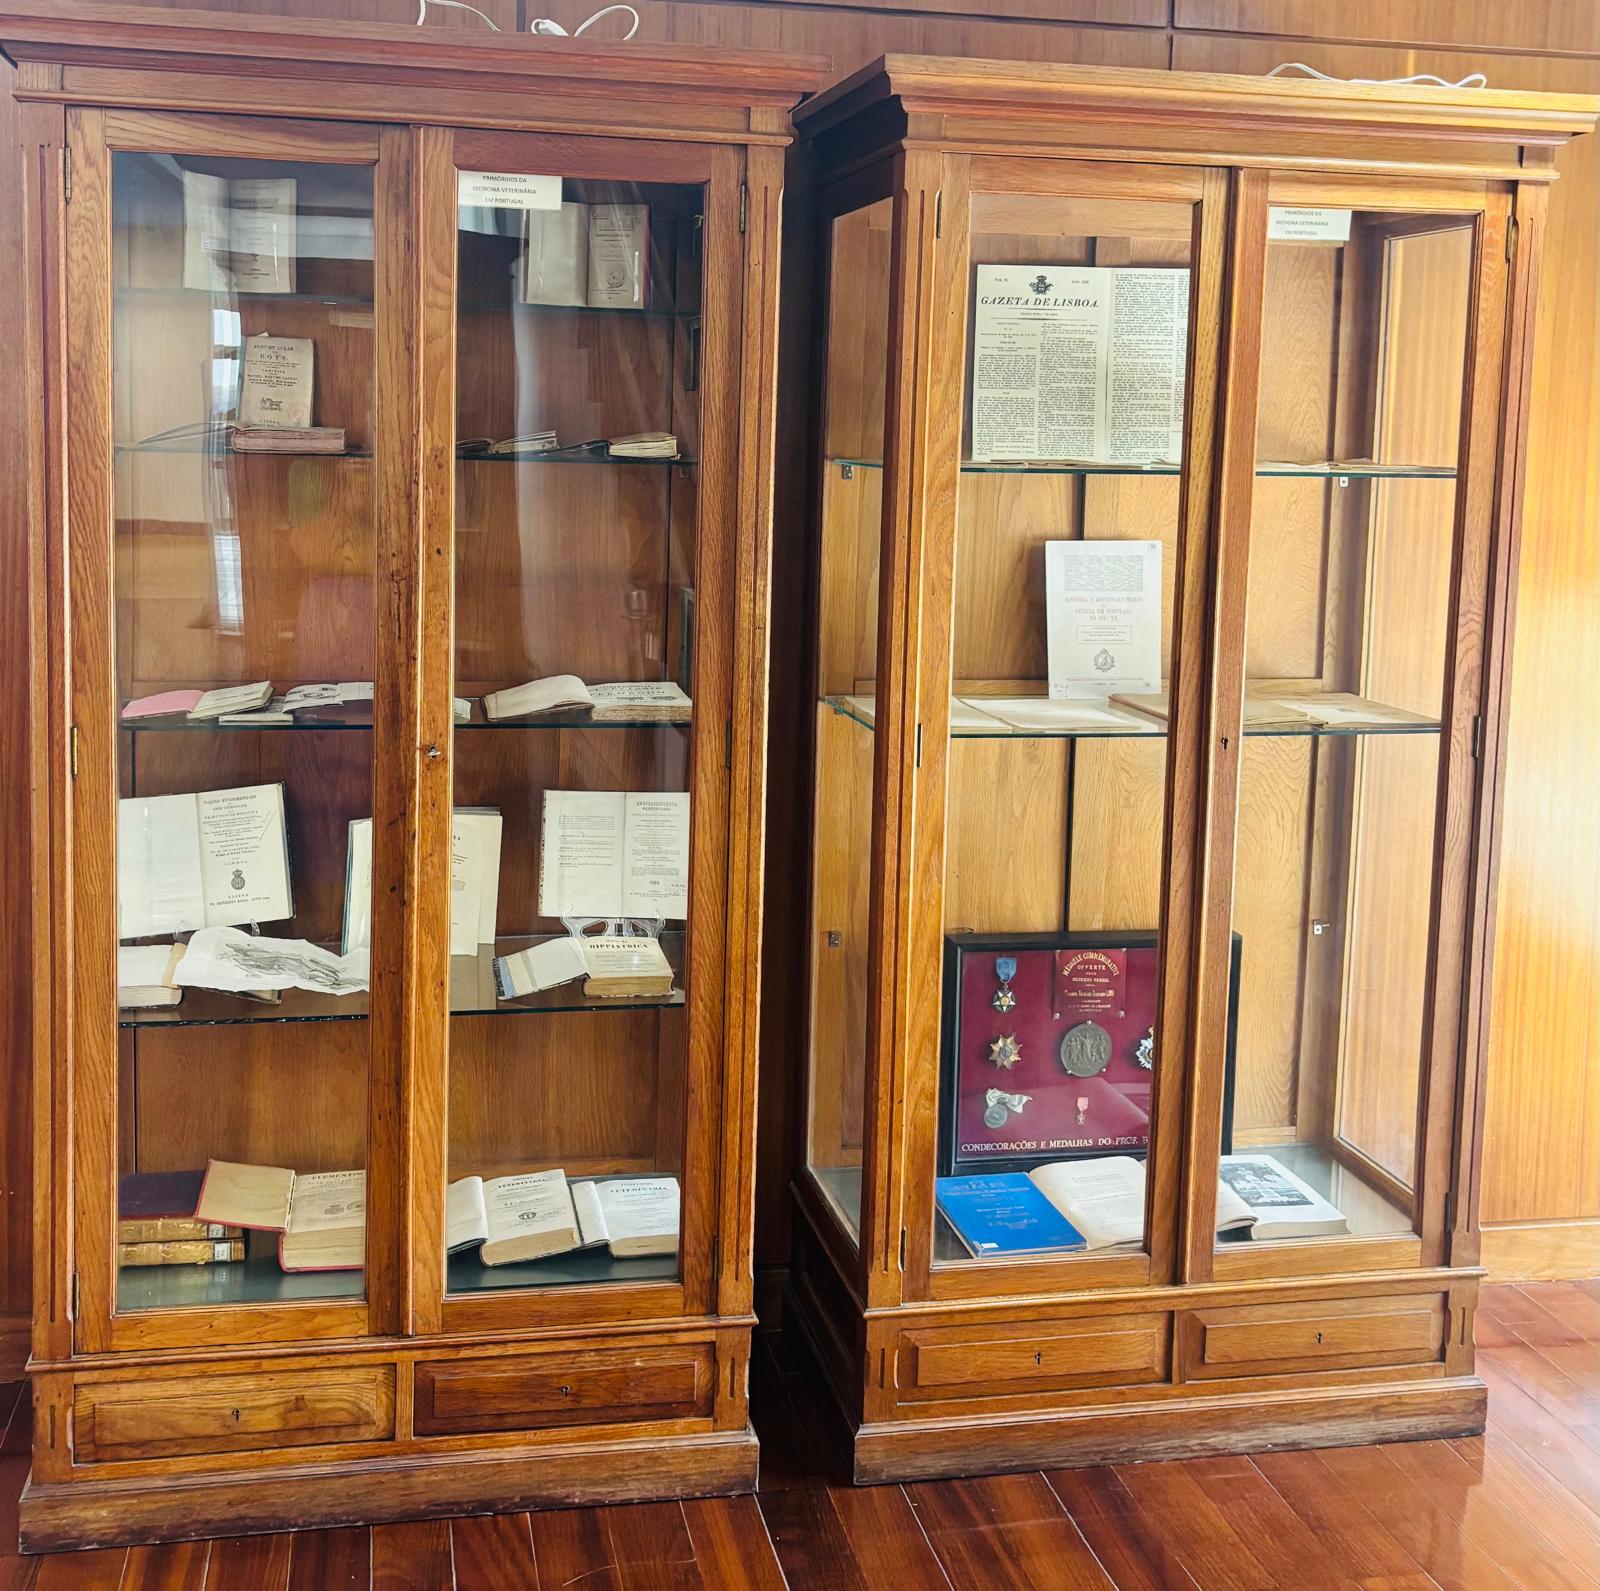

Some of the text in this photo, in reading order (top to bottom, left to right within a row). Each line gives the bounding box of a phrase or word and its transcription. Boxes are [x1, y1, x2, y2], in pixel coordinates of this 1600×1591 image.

[472, 185, 537, 195] MEDICINA VETERINÁRIA
[494, 197, 524, 205] PORTUGAL
[981, 296, 1029, 306] GAZETA
[1033, 297, 1050, 307] DE
[961, 1140, 1037, 1152] CONDECORAÇÕES
[1040, 1141, 1047, 1149] E
[1049, 1139, 1093, 1148] MEDALHAS
[1098, 1137, 1112, 1146] DO
